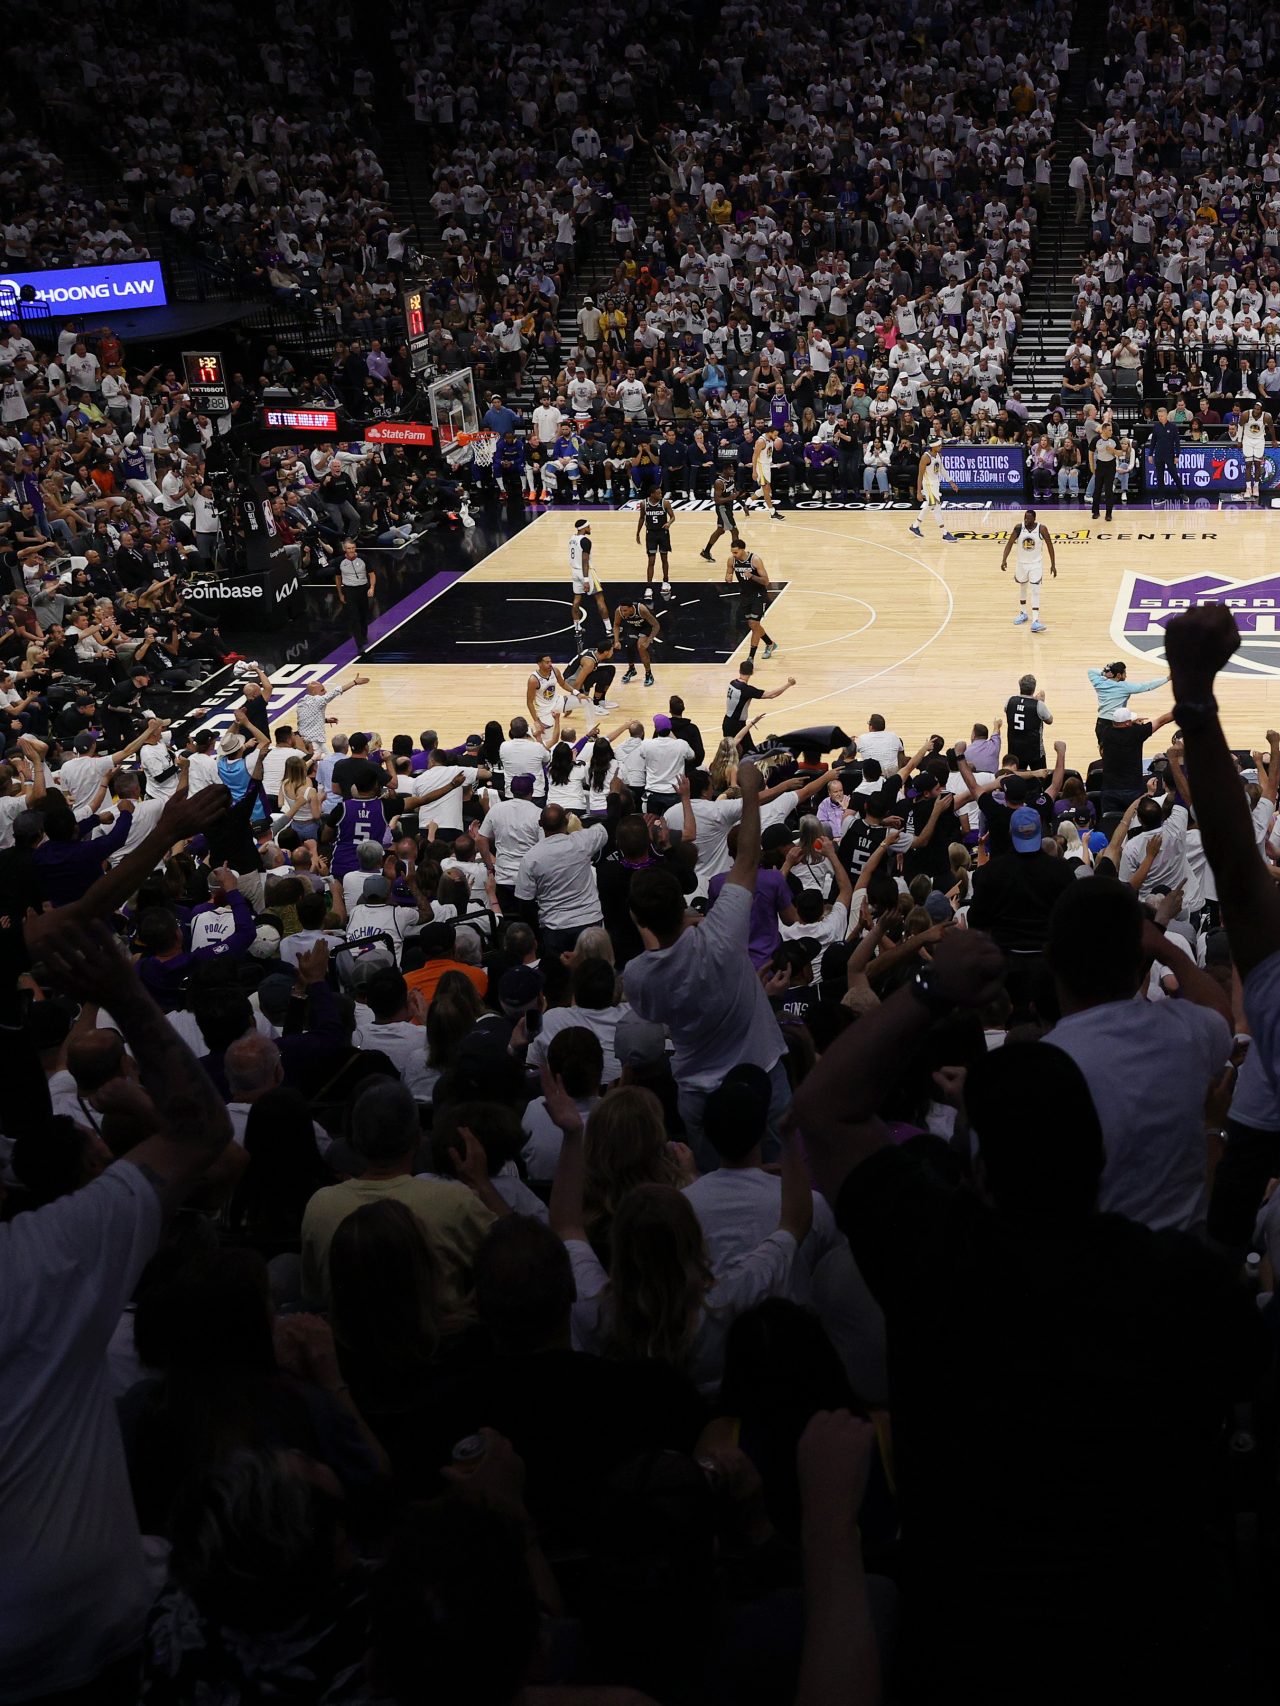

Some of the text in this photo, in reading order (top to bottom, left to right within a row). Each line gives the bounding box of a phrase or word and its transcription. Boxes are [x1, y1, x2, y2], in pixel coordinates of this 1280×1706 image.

[113, 280, 155, 296] LAW
[411, 310, 424, 334] 17
[200, 368, 215, 381] 17
[267, 412, 282, 425] GET
[977, 455, 1010, 470] CELTICS
[1211, 458, 1240, 480] 76
[999, 472, 1005, 483] ET
[1181, 472, 1190, 485] ET
[796, 500, 913, 511] Google
[652, 515, 659, 524] 5
[1096, 533, 1218, 541] CENTER
[570, 547, 576, 560] 8
[181, 583, 263, 600] coinbase
[1013, 713, 1025, 731] 5
[357, 810, 371, 820] FOX
[353, 822, 372, 846] 5
[858, 836, 873, 848] FOX
[850, 849, 871, 876] 5
[204, 924, 229, 935] POOLE
